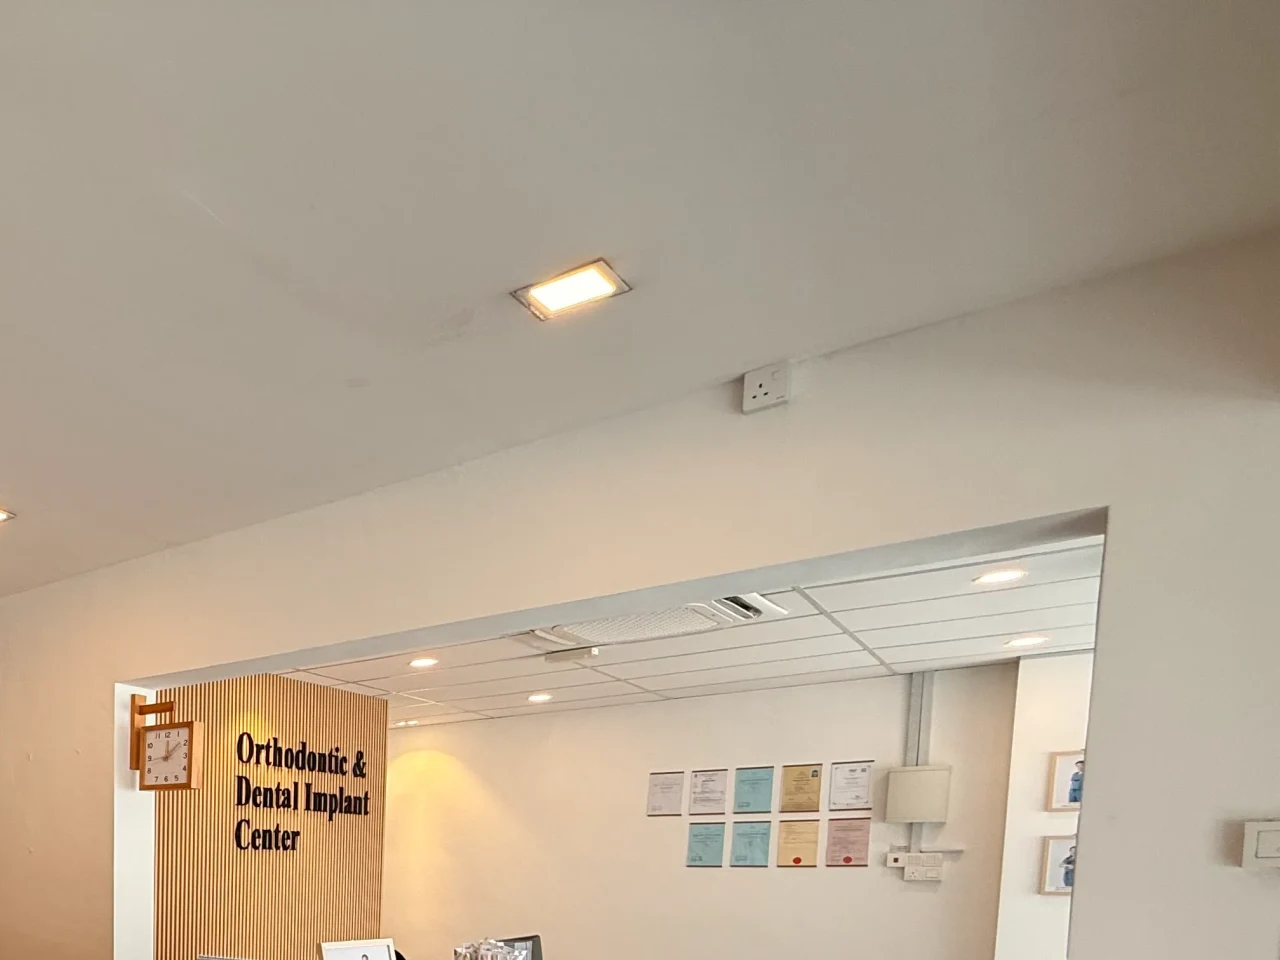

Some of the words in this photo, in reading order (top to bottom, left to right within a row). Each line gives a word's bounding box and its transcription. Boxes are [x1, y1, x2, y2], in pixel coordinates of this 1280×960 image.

[236, 732, 348, 776] Orthodontic
[352, 750, 366, 778] &
[235, 775, 299, 811] Dental
[304, 782, 370, 822] Implant
[235, 818, 301, 851] Center
